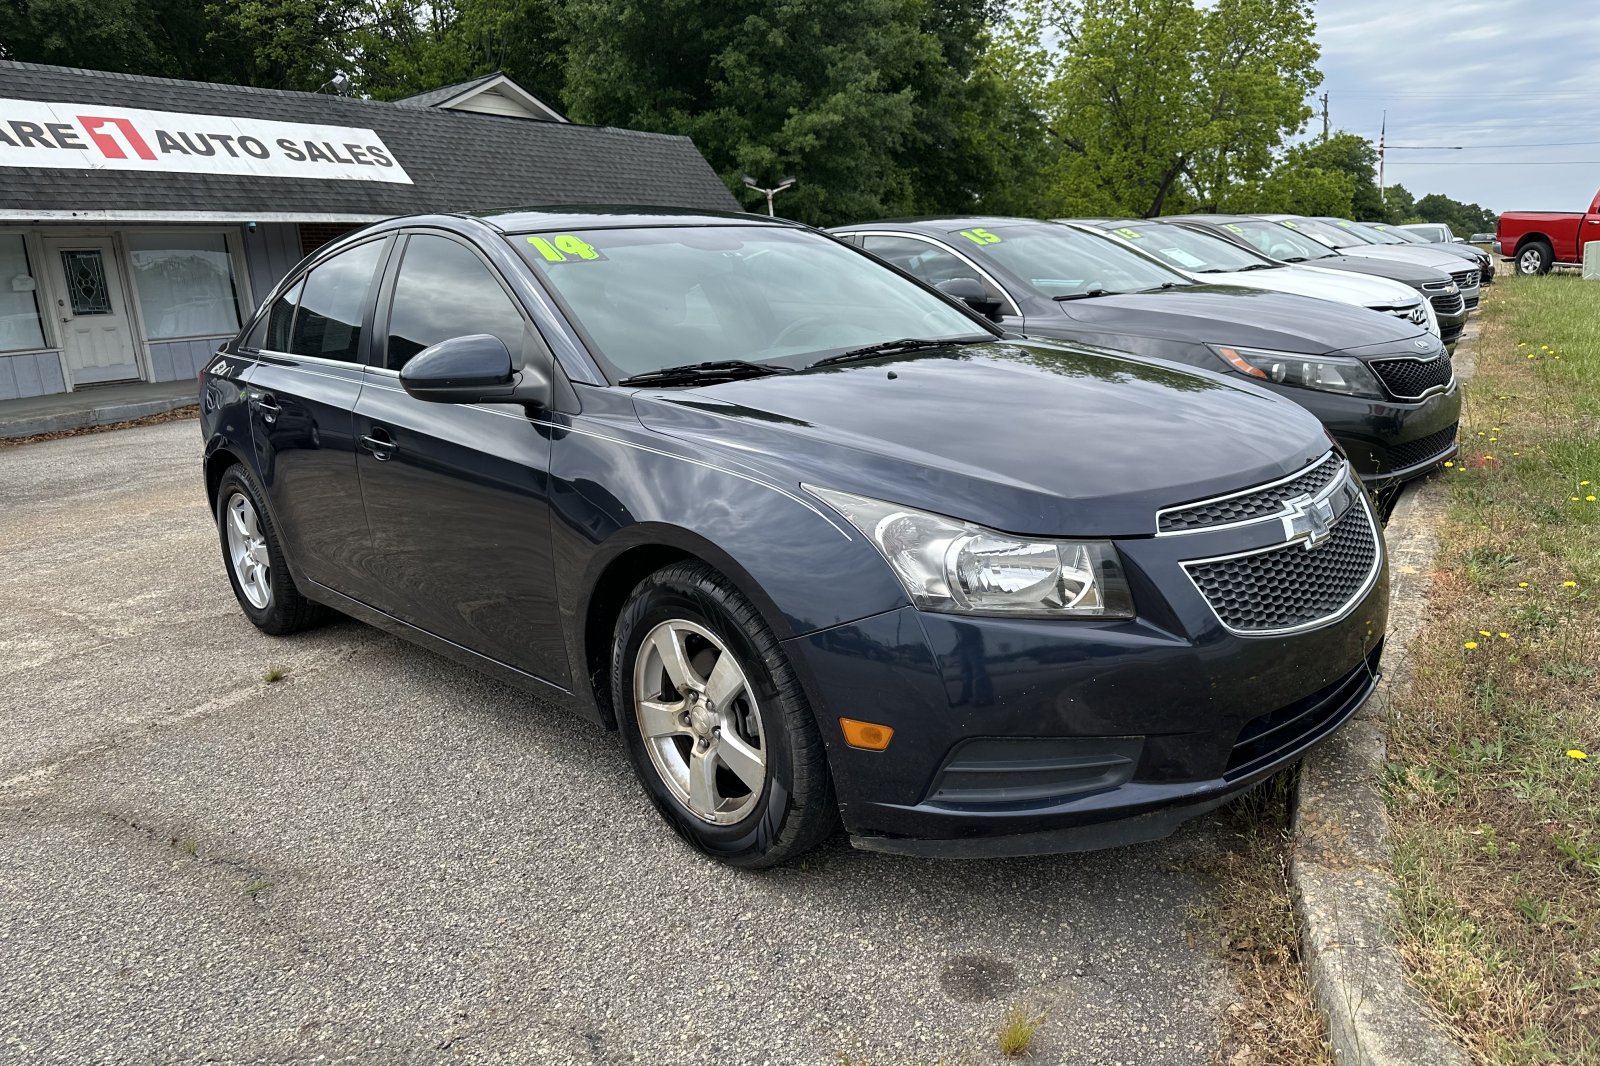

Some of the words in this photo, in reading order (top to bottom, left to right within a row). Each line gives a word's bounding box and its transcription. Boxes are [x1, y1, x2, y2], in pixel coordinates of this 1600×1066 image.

[90, 119, 145, 160] 1
[155, 129, 271, 160] AUTO
[276, 138, 394, 168] SALES
[527, 234, 600, 262] 14
[959, 228, 1002, 246] 15
